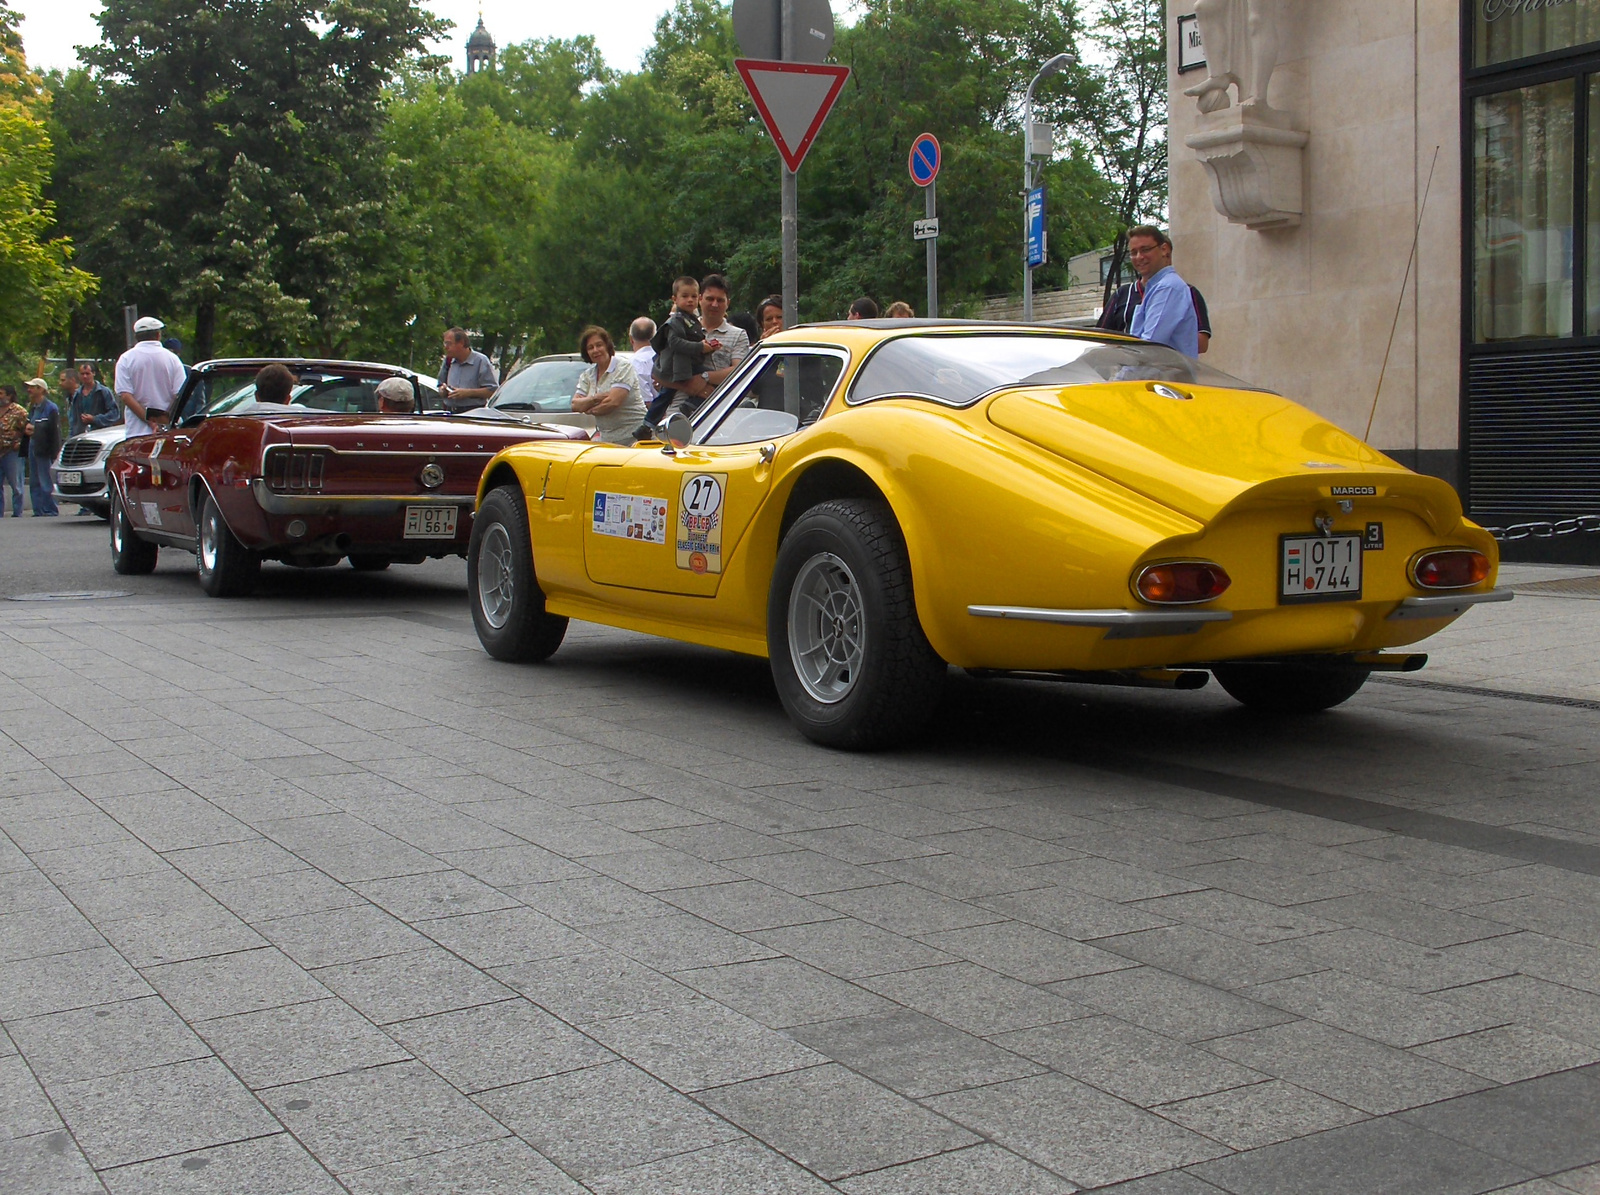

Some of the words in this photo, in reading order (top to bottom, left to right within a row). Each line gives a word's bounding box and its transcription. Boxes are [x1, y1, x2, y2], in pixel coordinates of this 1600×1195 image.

[689, 478, 714, 511] 27
[408, 521, 417, 530] H
[425, 521, 447, 533] 561
[1368, 525, 1379, 541] 3
[1287, 568, 1300, 586] H
[1315, 566, 1350, 590] 744
